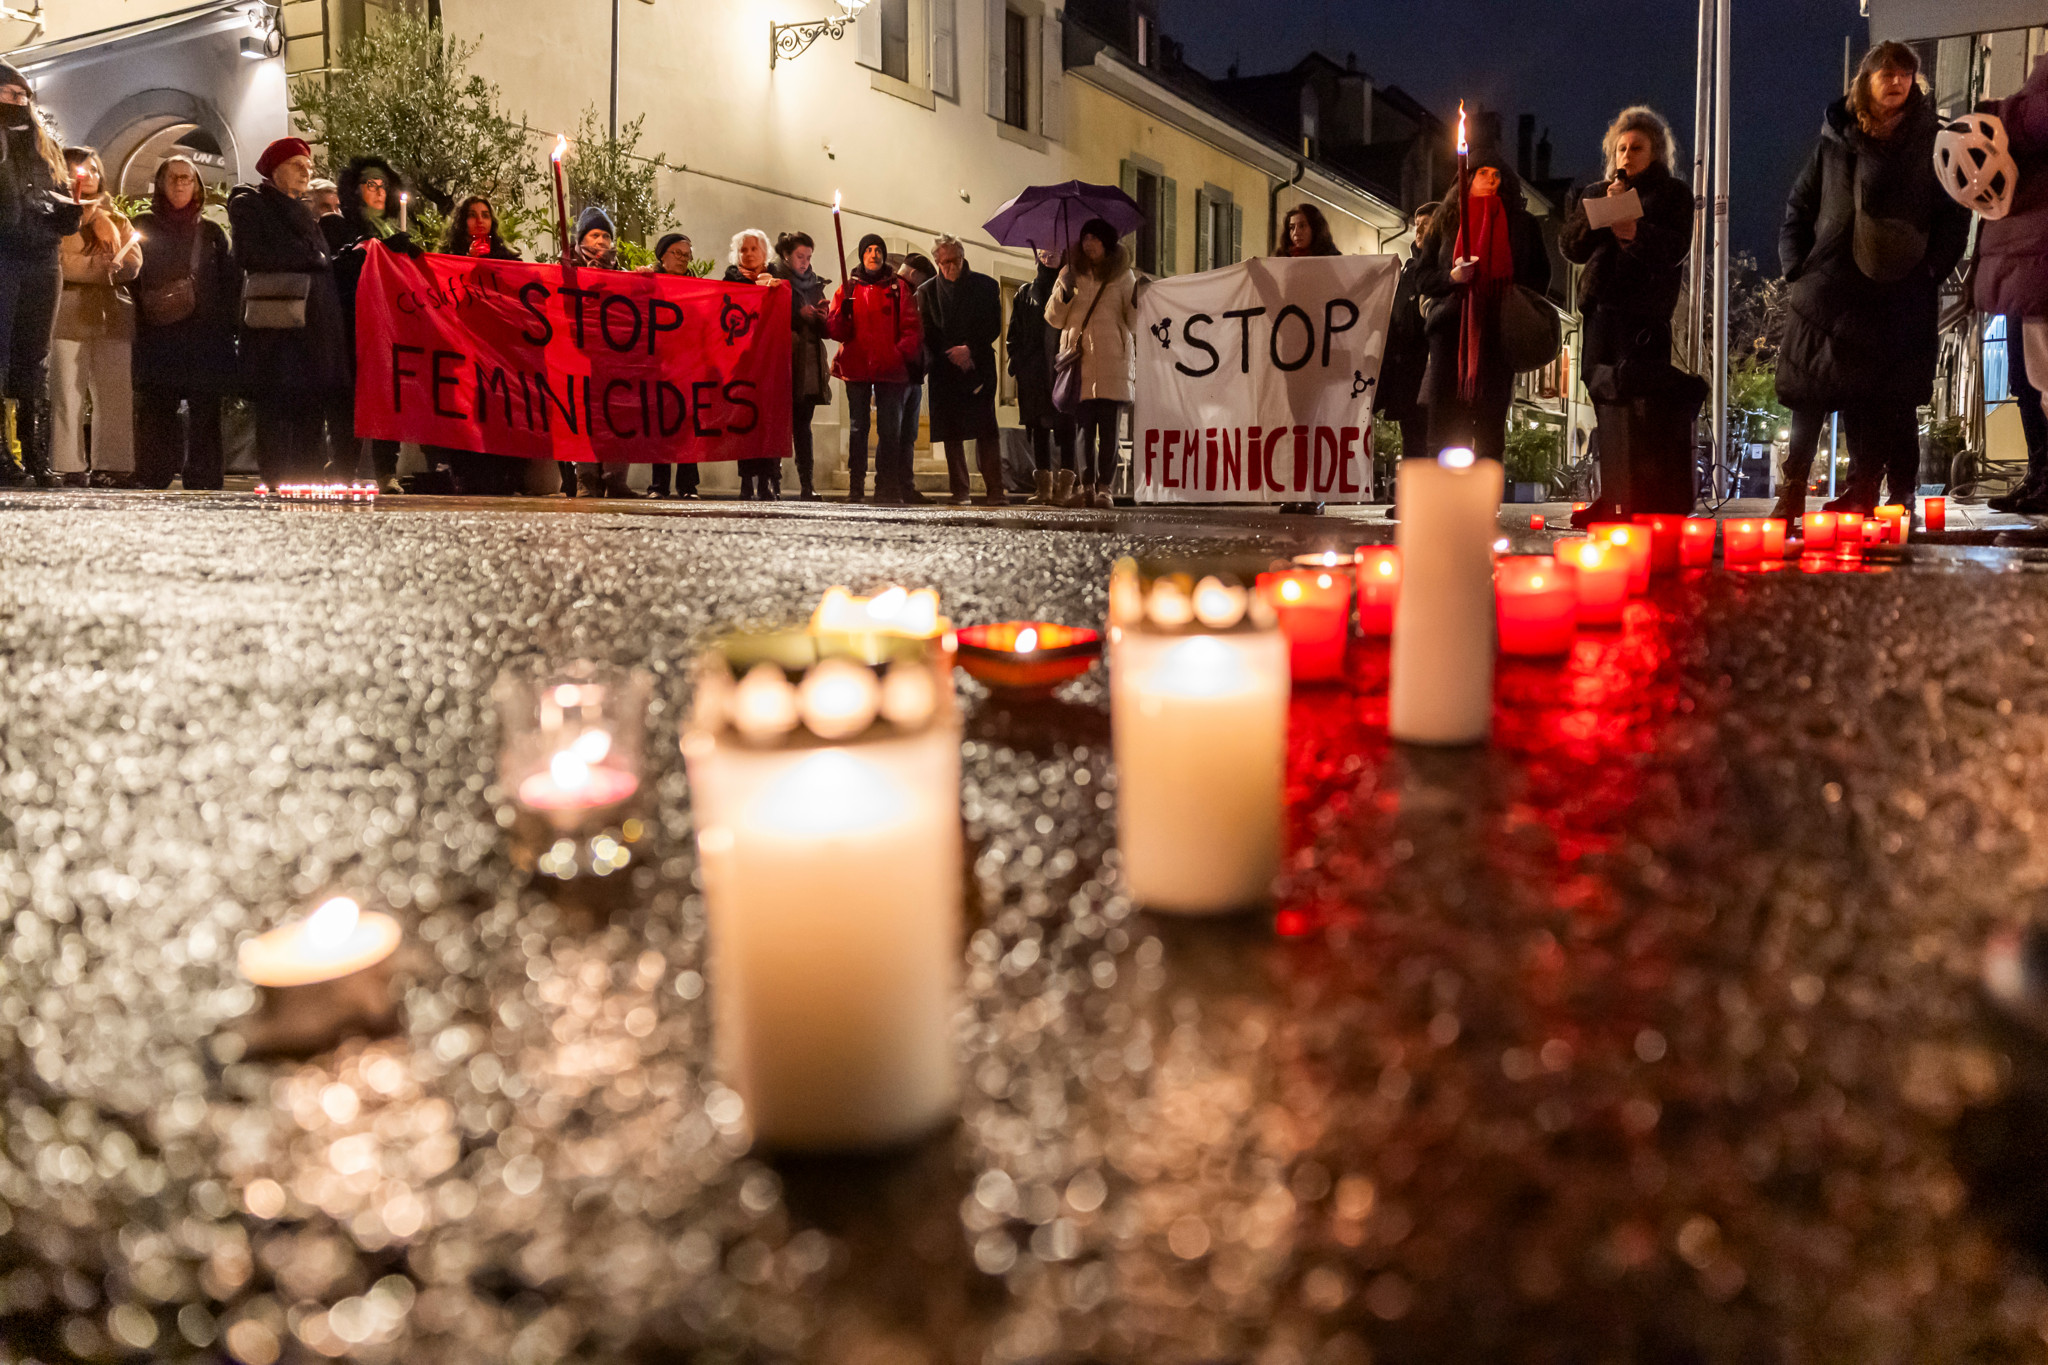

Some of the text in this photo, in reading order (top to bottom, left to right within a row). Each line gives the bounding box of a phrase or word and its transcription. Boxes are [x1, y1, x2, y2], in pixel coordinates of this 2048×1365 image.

[518, 281, 684, 356] STOP
[1175, 298, 1360, 378] STOP
[391, 342, 760, 440] FEMINICIDES
